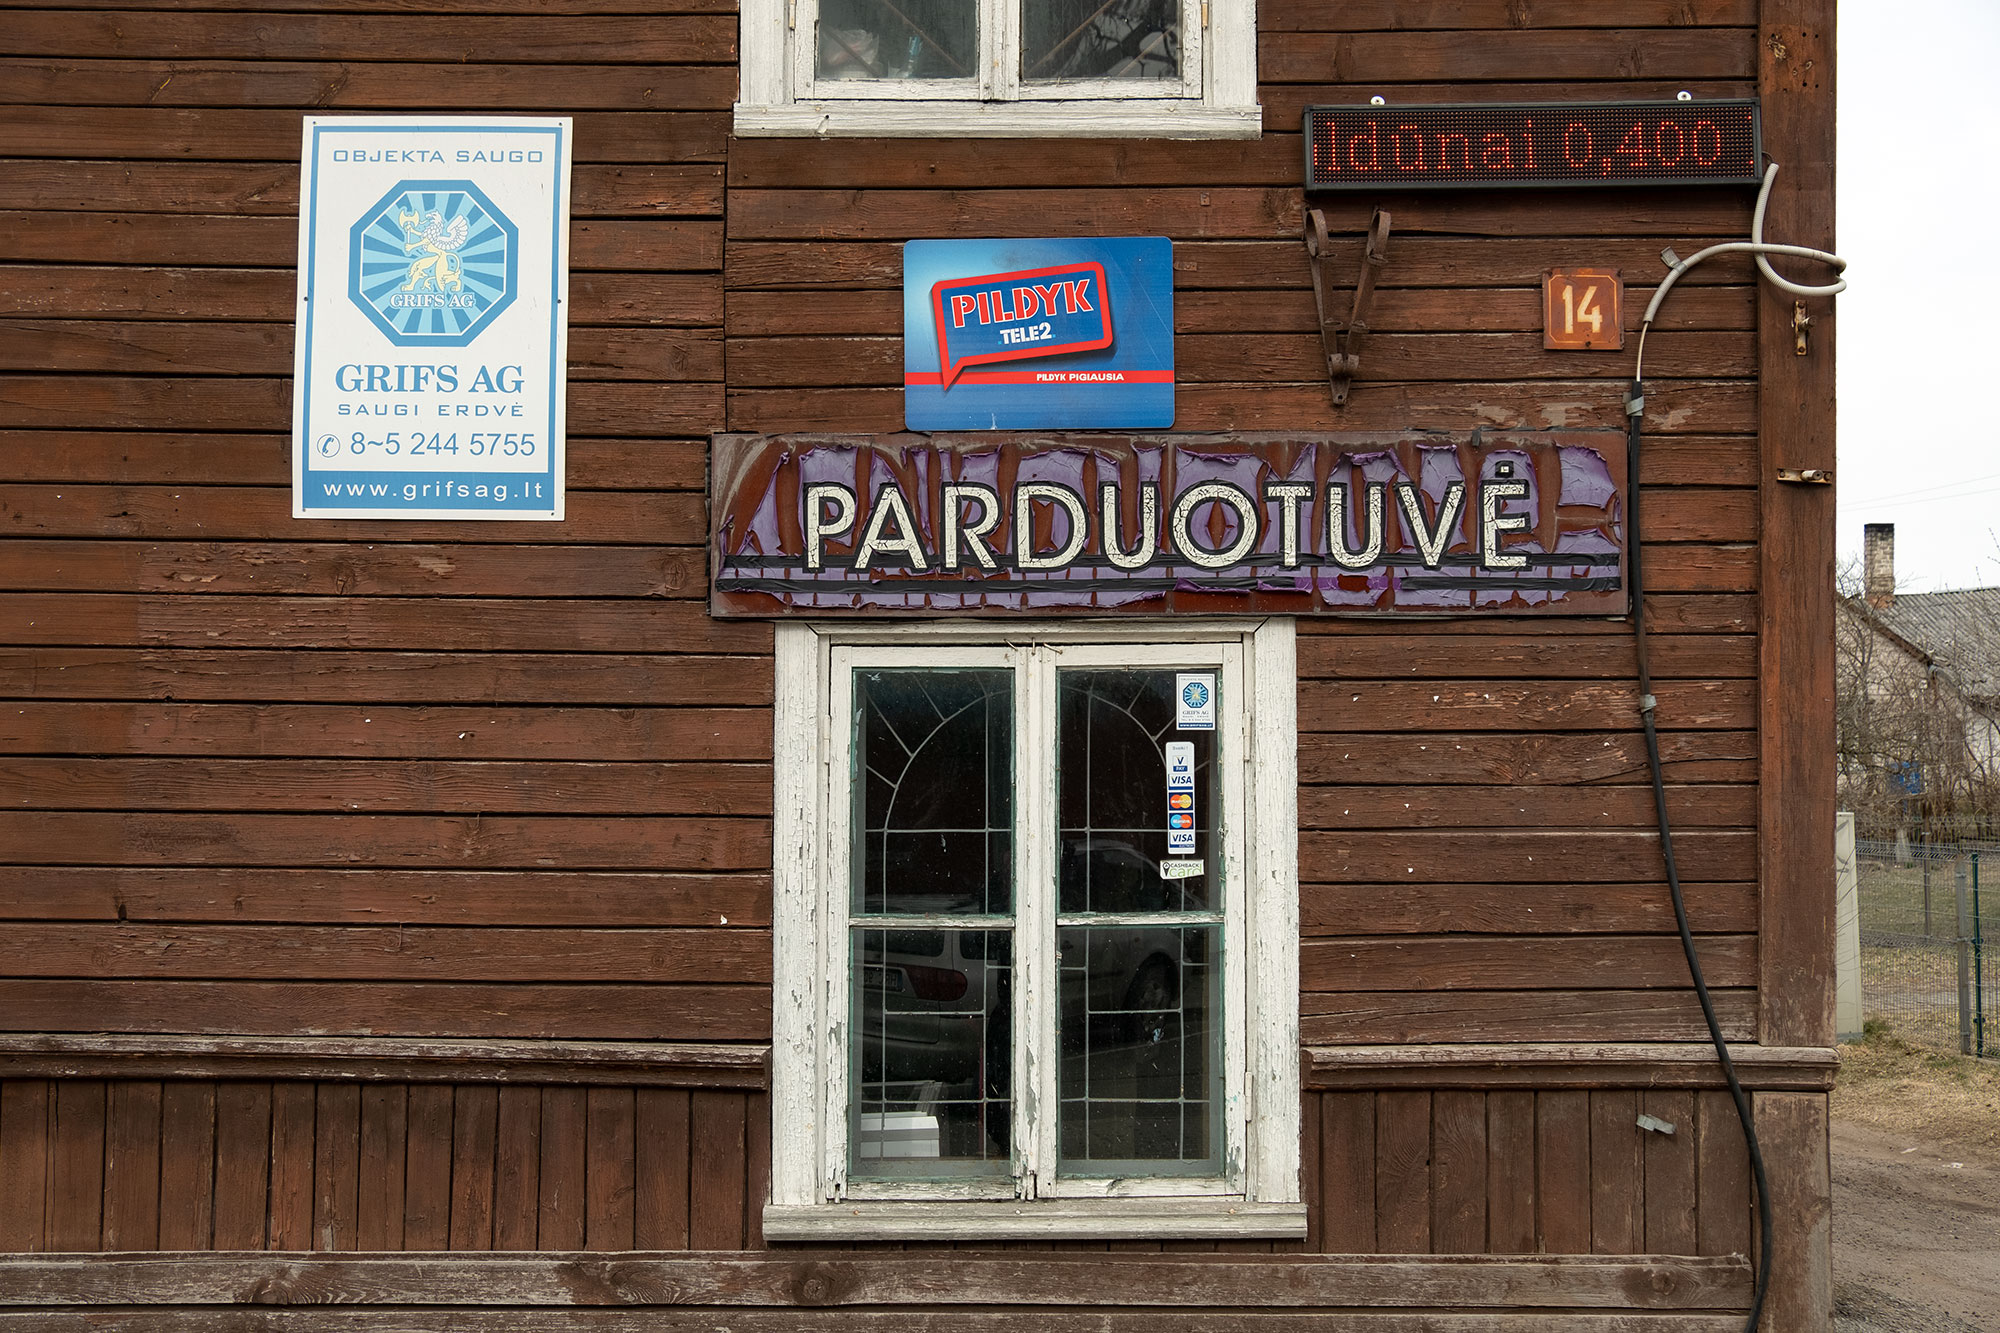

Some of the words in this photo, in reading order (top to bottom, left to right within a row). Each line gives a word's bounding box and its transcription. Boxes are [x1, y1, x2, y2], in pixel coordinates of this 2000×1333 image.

[333, 150, 445, 164] OBJEKTA
[456, 150, 543, 163] SAUGO
[1313, 119, 1537, 171] ldūnai
[1565, 121, 1721, 176] 0,400
[390, 294, 446, 308] GRIFS
[448, 294, 474, 308] AG
[951, 278, 1094, 328] PILDYK
[1561, 284, 1604, 335] 14
[1000, 322, 1053, 345] TELE2
[335, 364, 459, 393] GRIFS
[468, 365, 525, 393] AG
[1036, 373, 1066, 382] PILDYK
[1069, 373, 1124, 382] PIGIAUSIA
[338, 404, 419, 416] SAUGI
[438, 402, 524, 417] ERDVĖ
[410, 432, 459, 455] 244
[469, 433, 536, 456] 5755
[323, 481, 543, 502] www.grifsag.lt
[805, 463, 1529, 571] PARDUOTUVĖ
[1171, 776, 1192, 784] VISA
[1172, 834, 1193, 842] VISA
